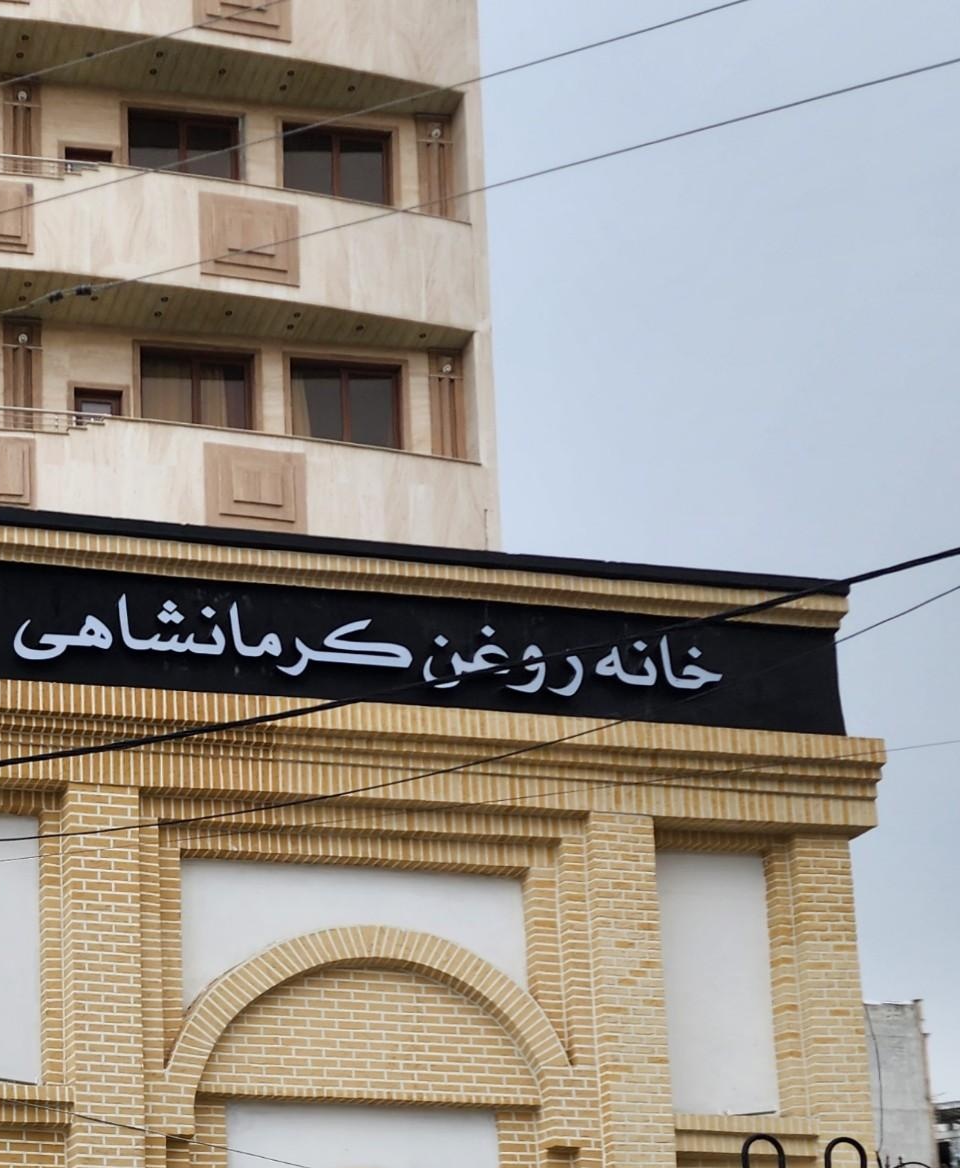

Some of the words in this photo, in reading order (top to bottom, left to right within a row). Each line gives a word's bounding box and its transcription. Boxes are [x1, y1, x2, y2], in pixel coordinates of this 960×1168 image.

[13, 593, 413, 676] کرمانشاهی
[423, 625, 584, 697] روغن
[596, 635, 723, 689] خانه
